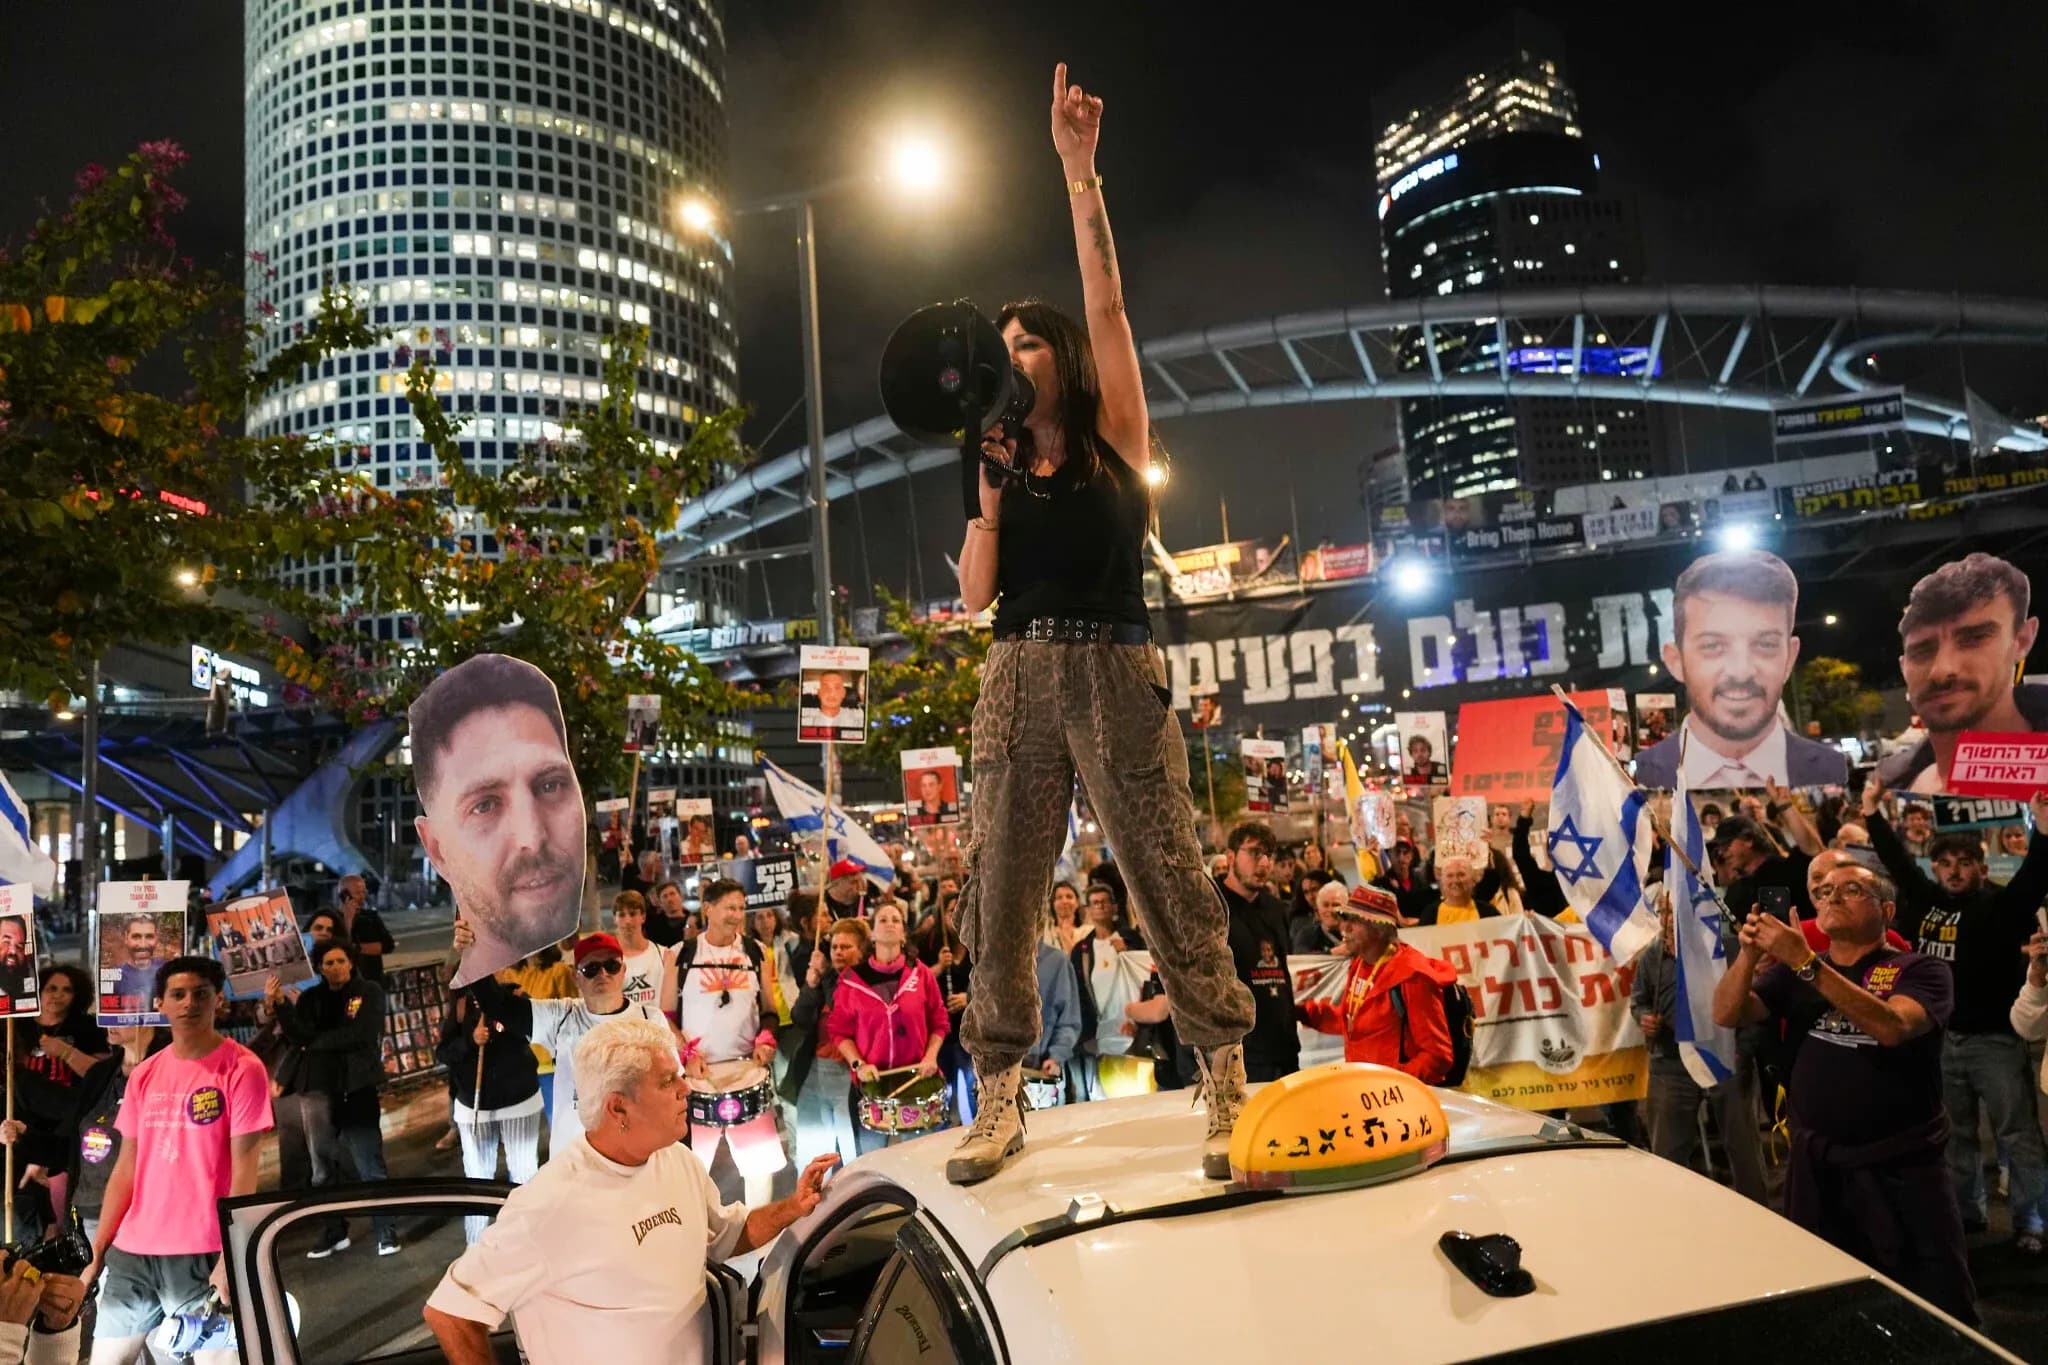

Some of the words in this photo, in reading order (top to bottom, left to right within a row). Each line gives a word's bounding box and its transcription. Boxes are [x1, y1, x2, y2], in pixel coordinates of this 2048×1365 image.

[1466, 530, 1499, 548] Bring
[1501, 526, 1536, 543] Them
[1538, 521, 1574, 539] Home
[1408, 598, 1570, 688] כולם
[1158, 623, 1385, 710] בפעימ
[1535, 706, 1606, 728] קדם
[1962, 746, 2021, 759] החטוף
[2022, 746, 2048, 760] עד
[1966, 765, 2037, 779] האחרון
[756, 861, 792, 876] קודם
[757, 872, 794, 893] כל
[1441, 932, 1612, 976] חזירים
[1583, 1079, 1600, 1089] ניר
[1602, 1073, 1635, 1087] קיבוץ
[1360, 1085, 1404, 1110] 01241
[1492, 1085, 1516, 1098] לכם
[1520, 1085, 1554, 1096] מחכה
[631, 1206, 682, 1246] LEGENDS
